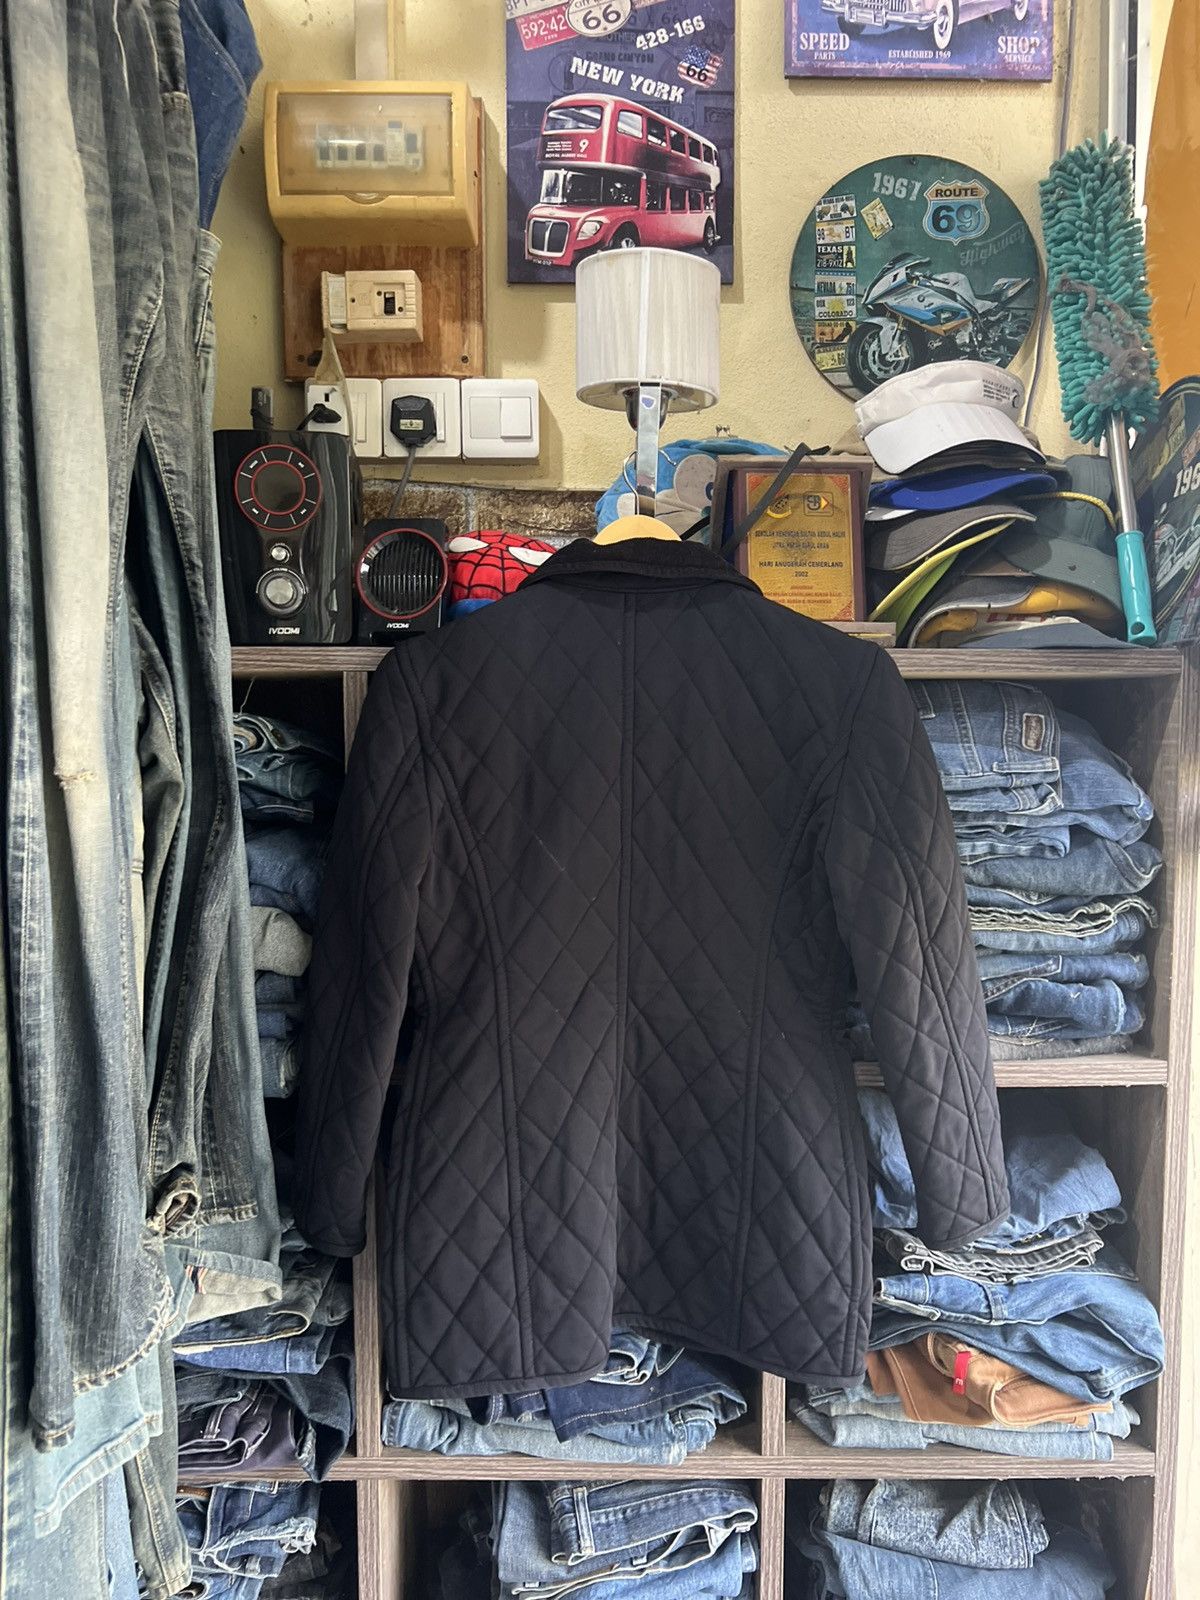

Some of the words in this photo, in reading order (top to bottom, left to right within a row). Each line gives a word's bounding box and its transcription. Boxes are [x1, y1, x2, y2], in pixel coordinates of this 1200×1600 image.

[583, 4, 621, 30] 66
[635, 15, 706, 50] 428-166
[800, 32, 850, 50] SPEED
[888, 49, 934, 58] ESTABLISHED
[997, 36, 1041, 54] SHOP
[814, 52, 836, 60] PARTS
[570, 56, 625, 86] NEW
[630, 74, 685, 104] YORK
[687, 64, 709, 82] 66
[580, 138, 590, 153] 9
[872, 172, 923, 201] 1967
[935, 187, 979, 198] ROUTE
[931, 204, 981, 233] 69
[817, 245, 843, 253] TEXAS
[818, 310, 853, 318] COLORADO
